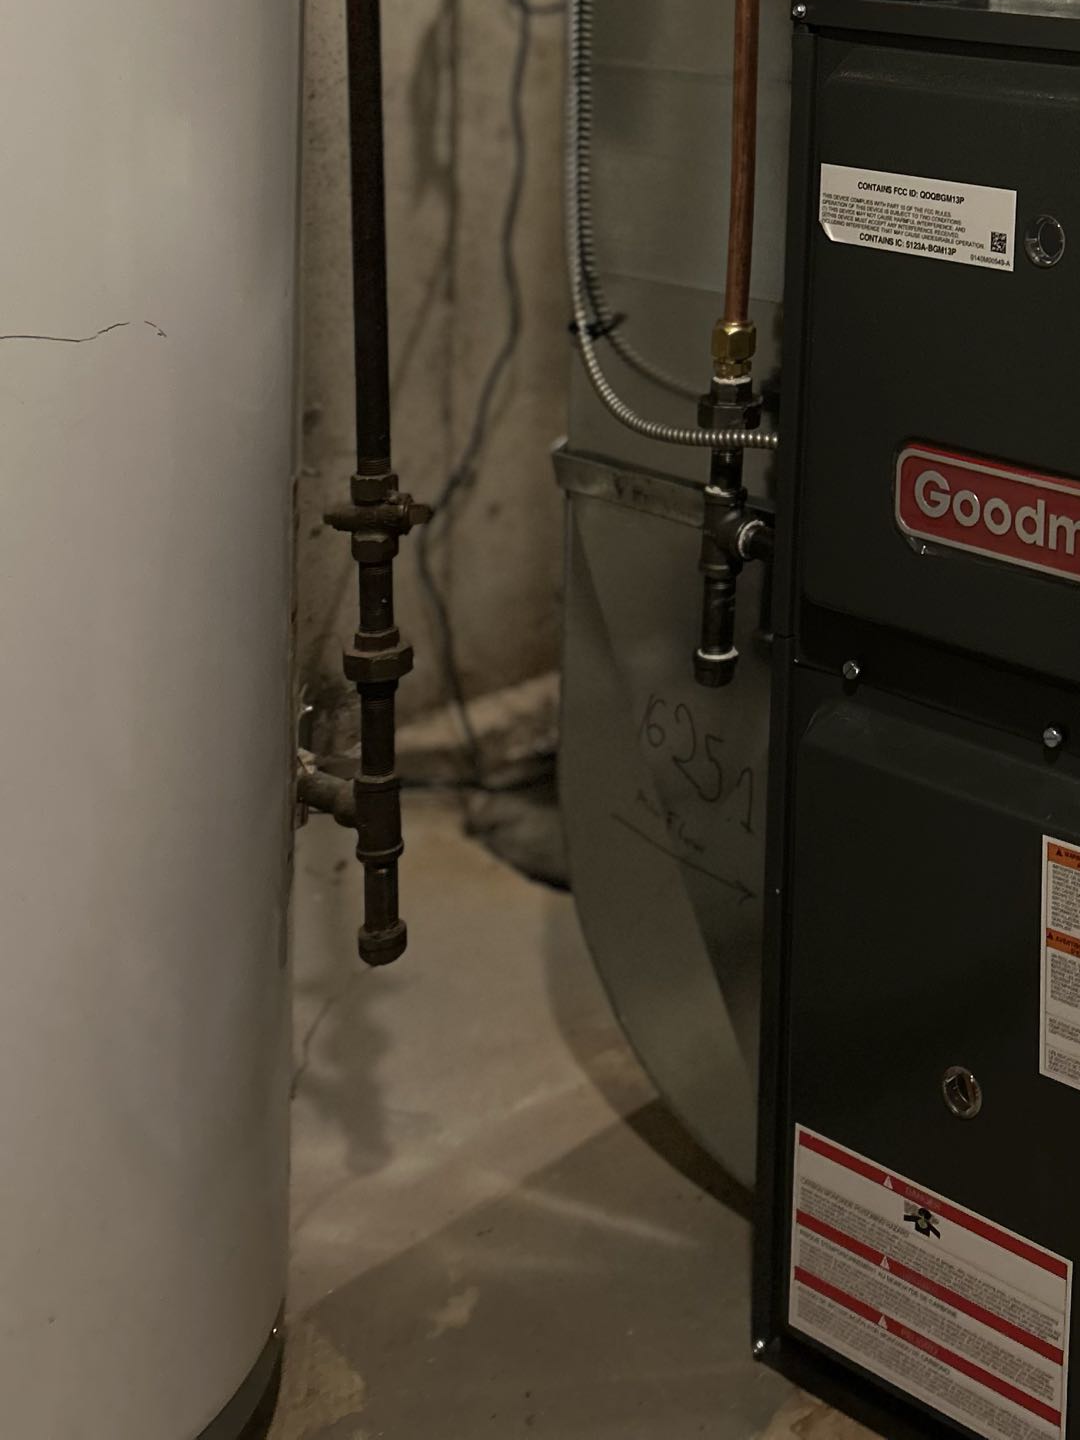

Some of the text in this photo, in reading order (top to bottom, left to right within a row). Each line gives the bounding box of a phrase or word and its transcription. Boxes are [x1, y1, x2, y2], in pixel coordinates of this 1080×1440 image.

[857, 181, 892, 194] CONTAINS
[893, 187, 908, 196] FCC
[909, 189, 918, 198] ID:
[859, 232, 957, 255] CONTAINS IC: 5123A-BGM13P
